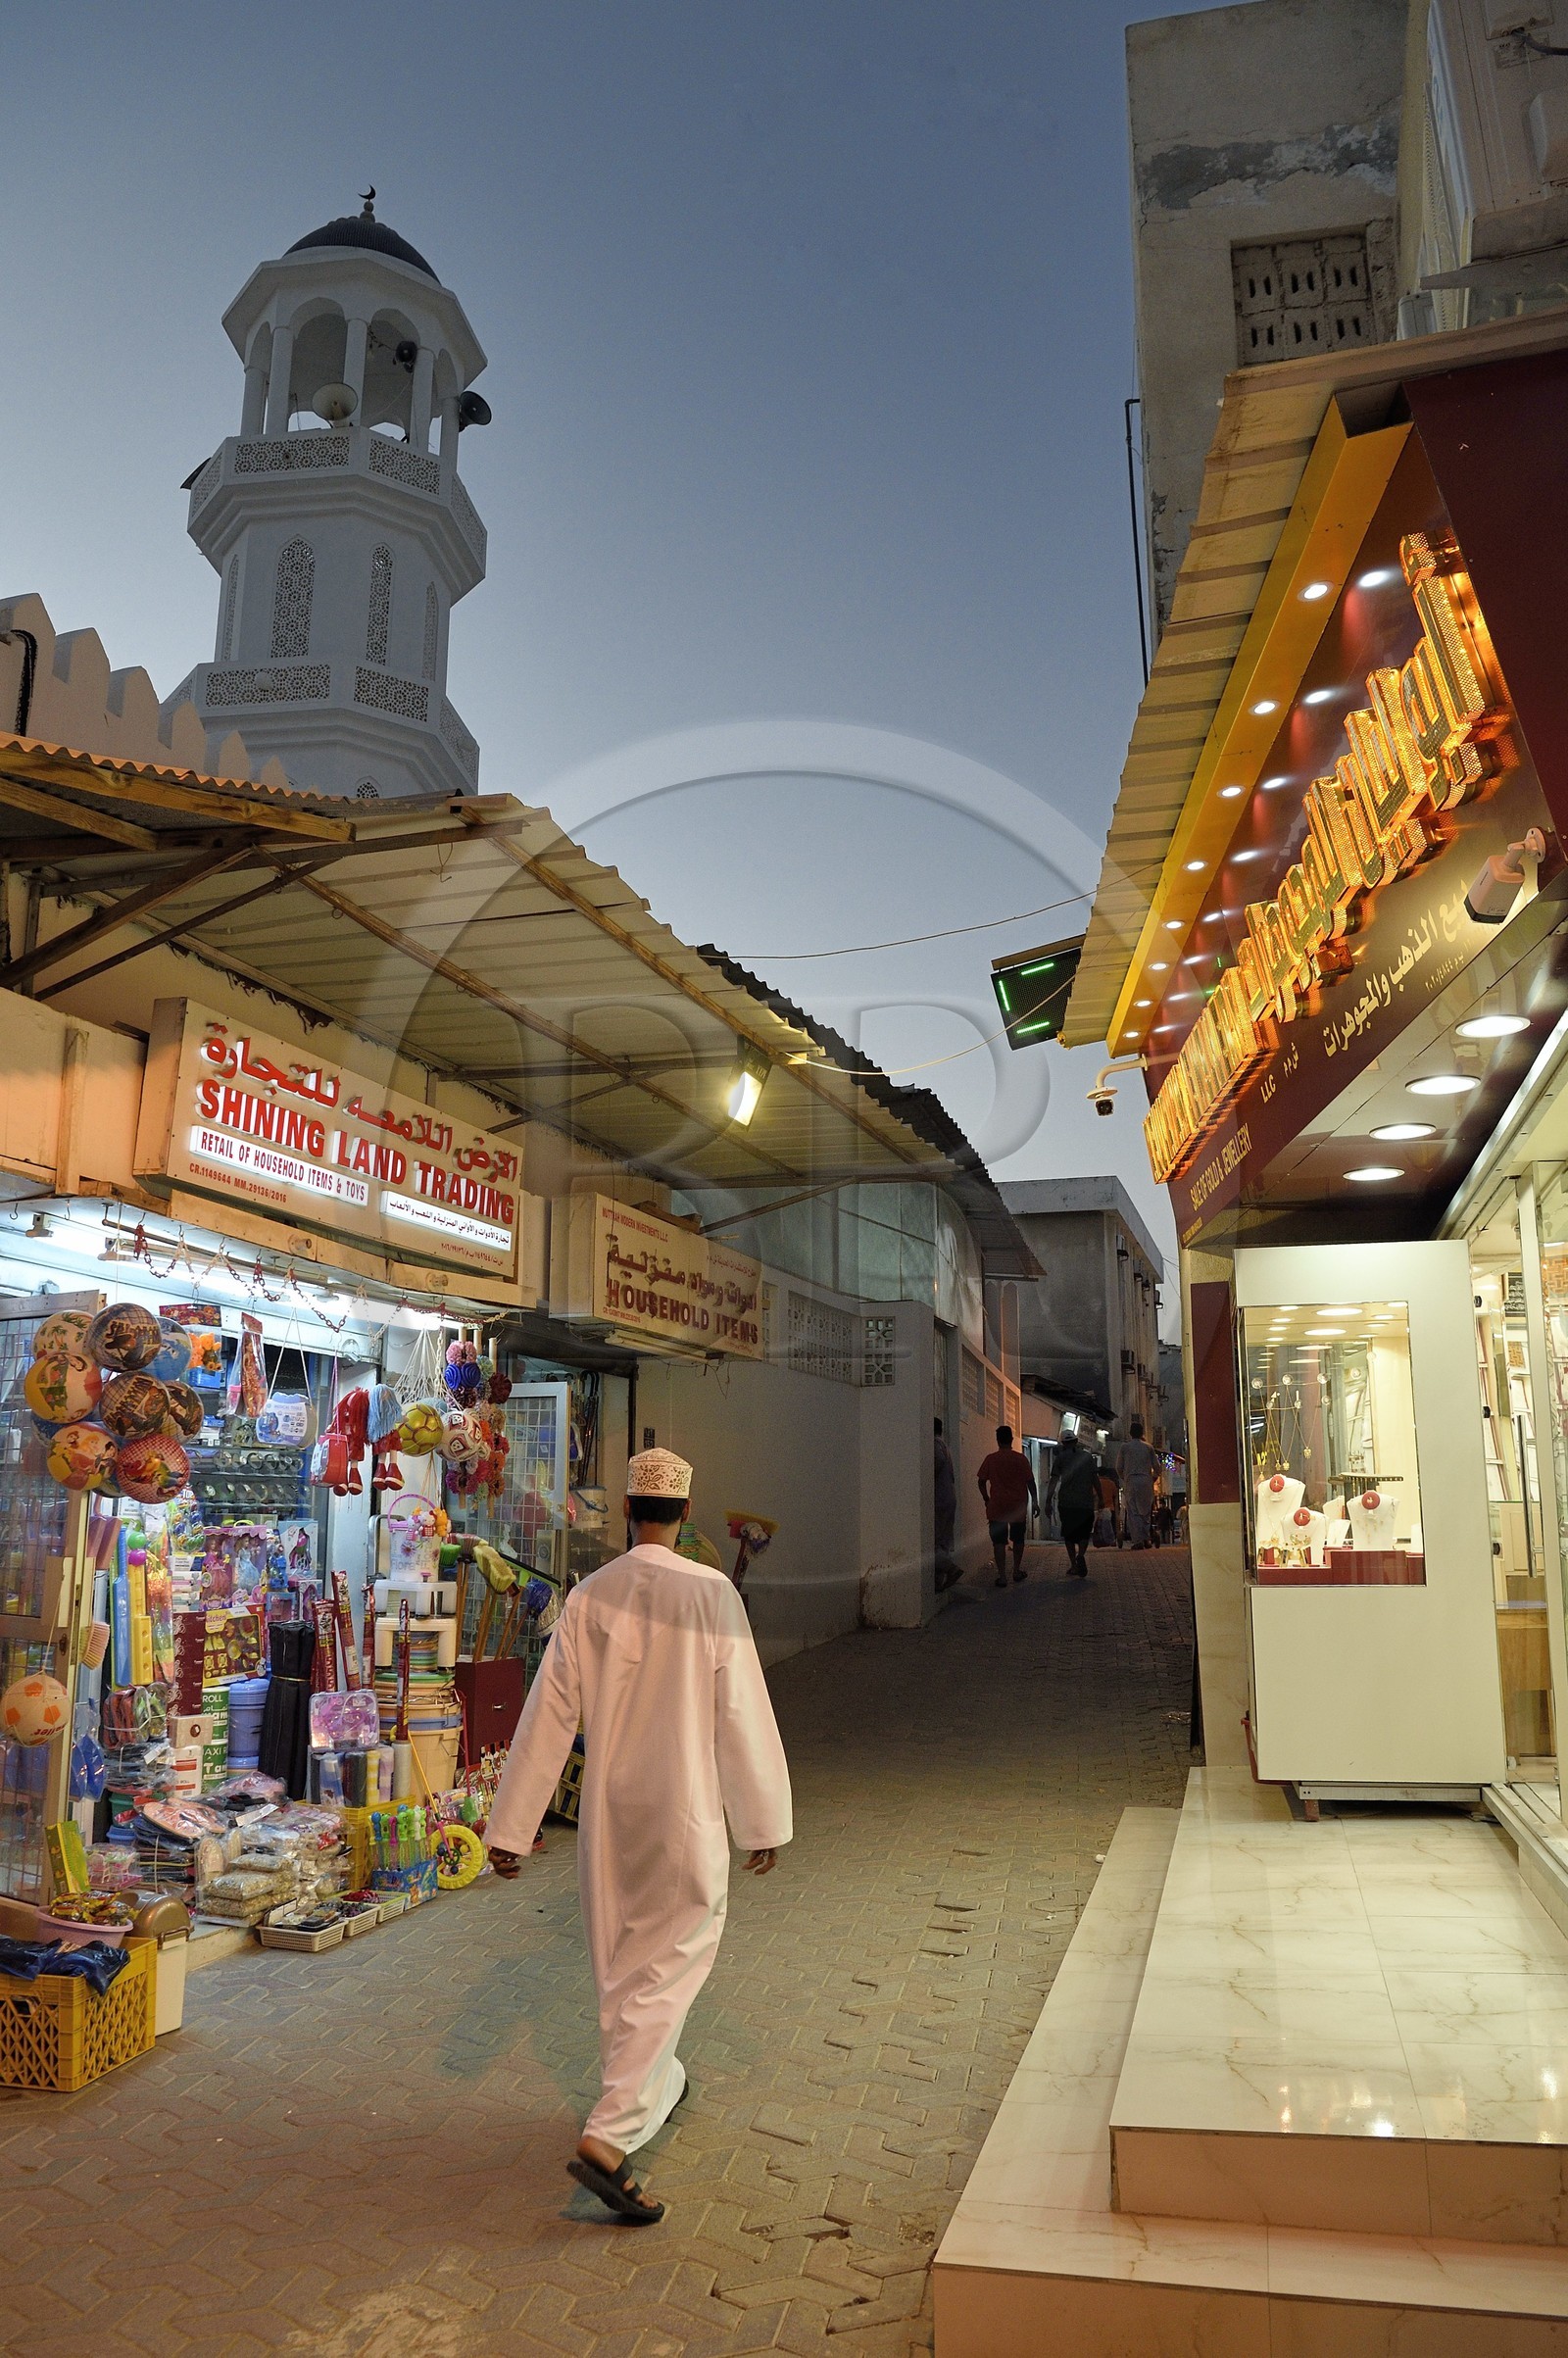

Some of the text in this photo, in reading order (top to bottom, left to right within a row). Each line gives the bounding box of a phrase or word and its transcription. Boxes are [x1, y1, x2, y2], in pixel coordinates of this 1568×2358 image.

[1389, 909, 1439, 992] الذهب
[1324, 973, 1392, 1057] والمجوهرات
[204, 1022, 341, 1107] للتجارة
[1260, 1074, 1276, 1104] LLC
[199, 1079, 514, 1225] SHINING LAND TRADING
[201, 1131, 366, 1202] RETAIL OF HOUSEHOLD ITEMS & TOYS
[1221, 1123, 1252, 1175] JEWELLERY
[495, 1232, 510, 1247] تجارة
[620, 1214, 635, 1229] MODERN
[607, 1278, 758, 1344] HOUSEHOLD ITEMS
